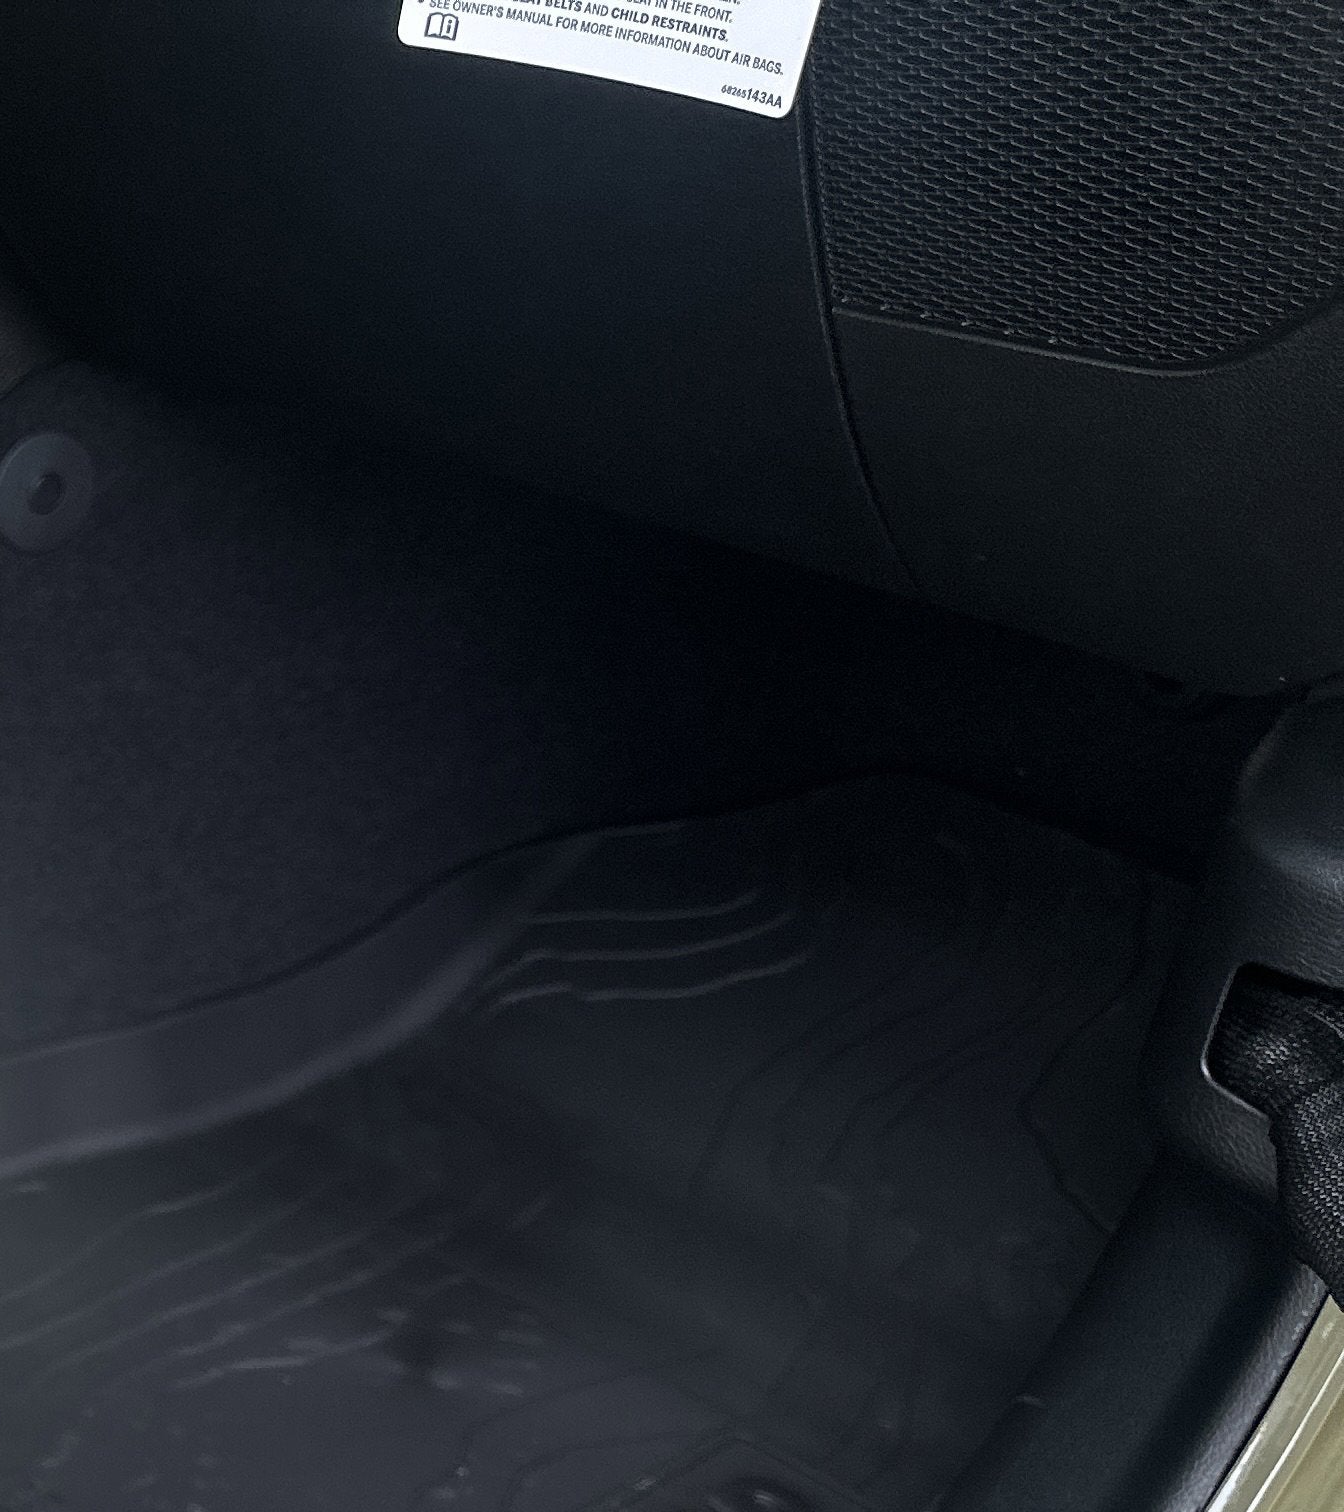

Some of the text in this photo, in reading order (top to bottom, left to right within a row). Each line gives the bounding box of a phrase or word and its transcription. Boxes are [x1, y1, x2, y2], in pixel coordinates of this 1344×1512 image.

[583, 2, 609, 17] AND
[611, 7, 650, 24] CHILD
[651, 15, 728, 42] RESTRAINTS.
[671, 0, 693, 14] THE
[693, 4, 733, 23] FRONT.
[429, 0, 784, 75] SEE OWNER'S MANUAL FOR MORE INFORMATION ABOUT AIR BAGS.
